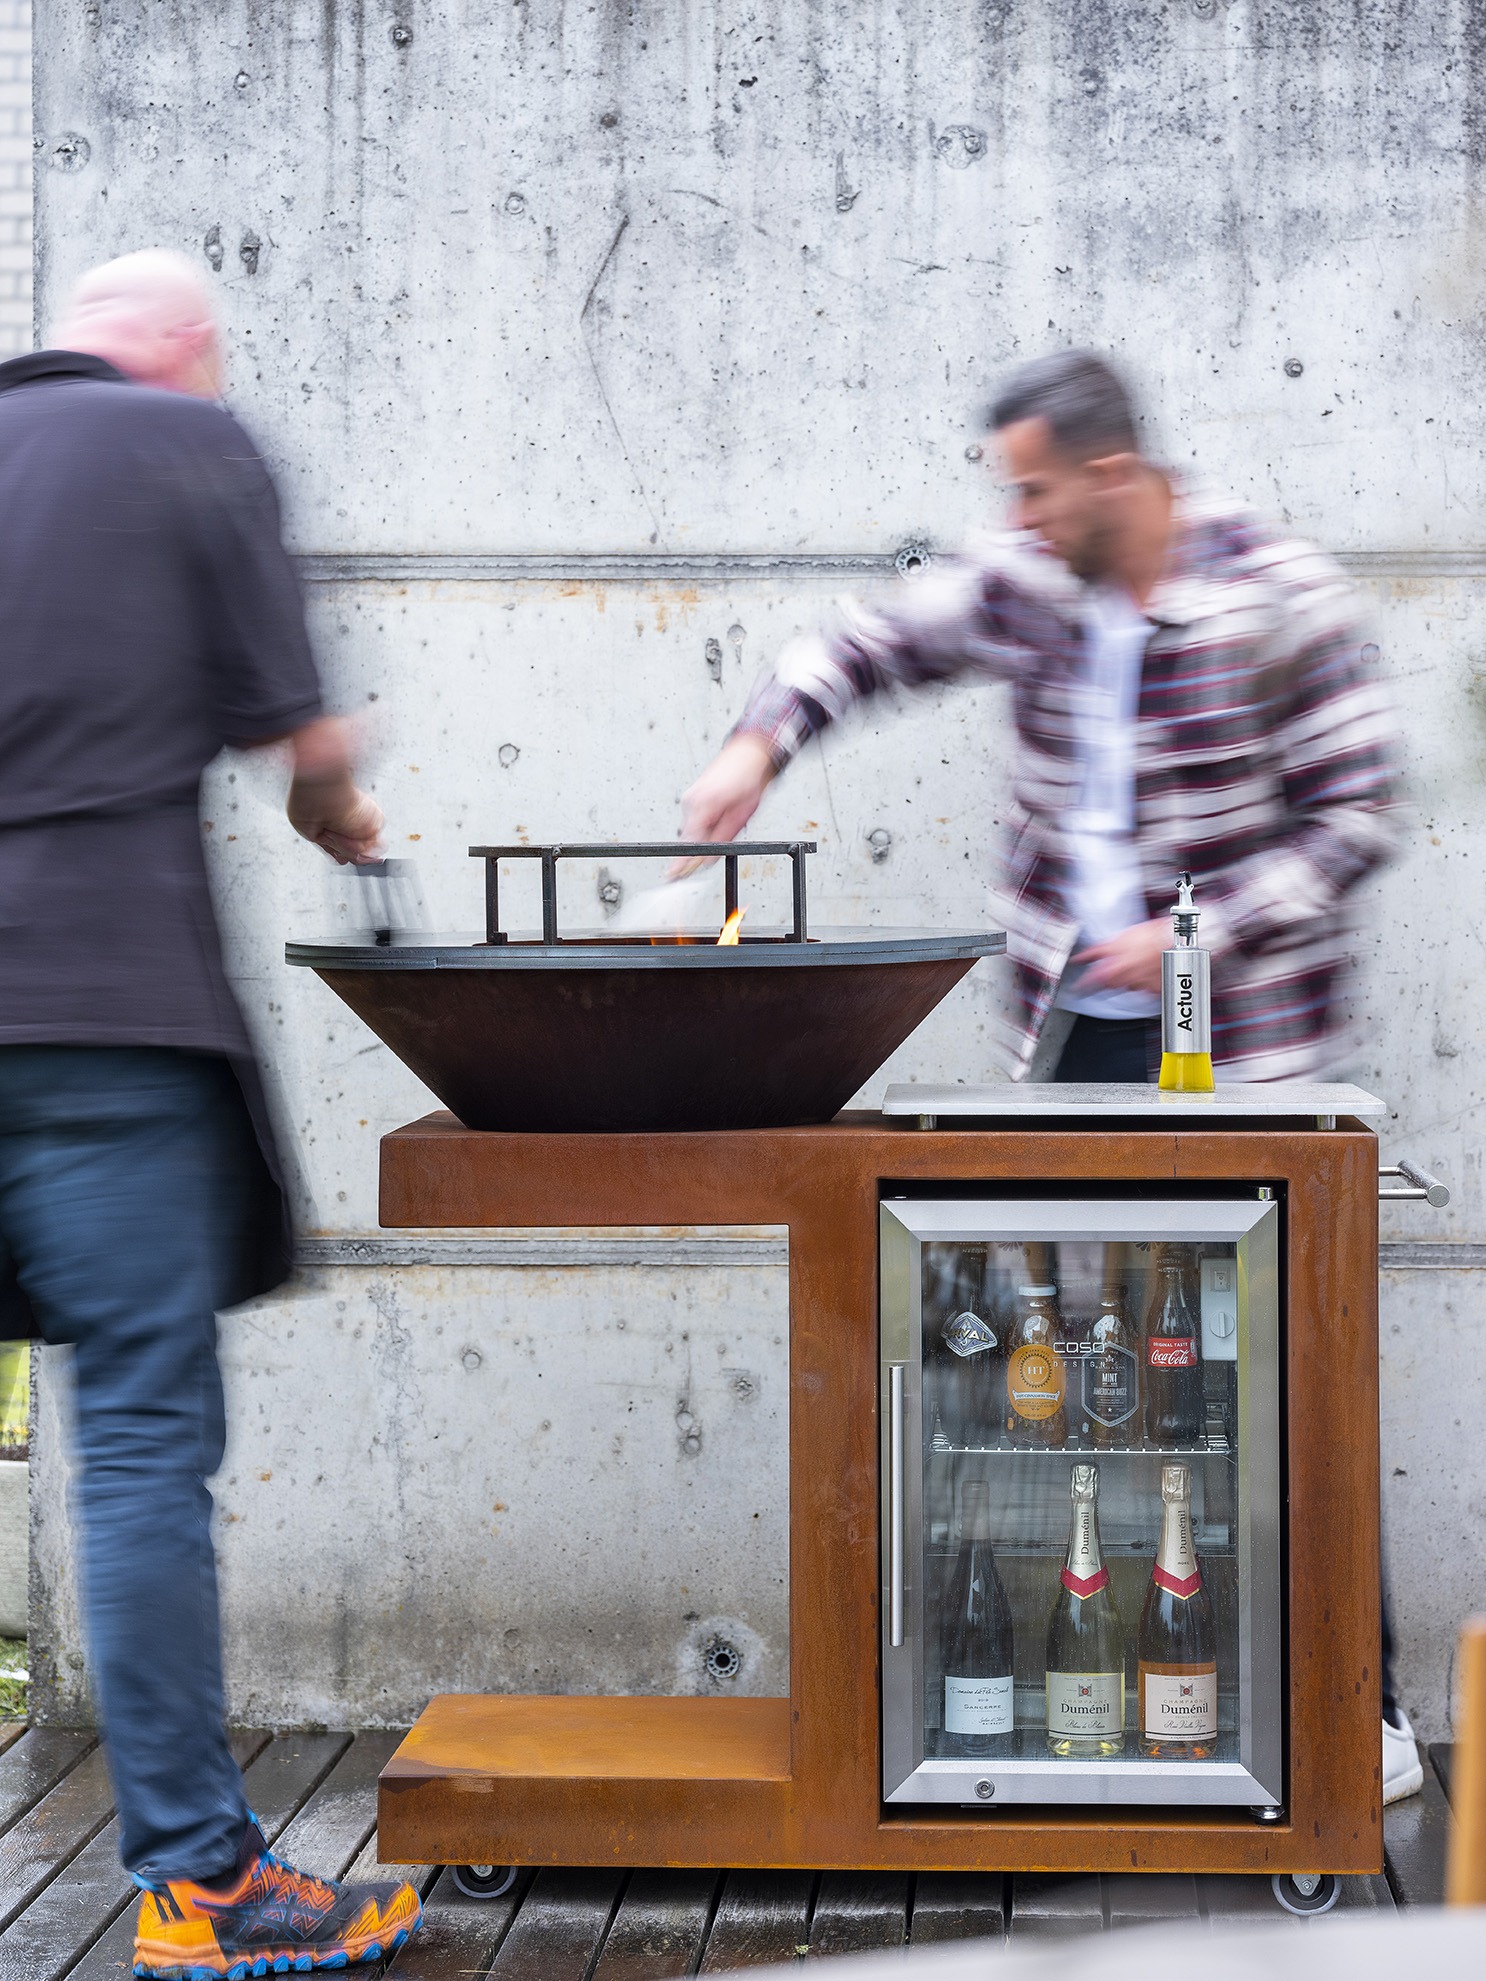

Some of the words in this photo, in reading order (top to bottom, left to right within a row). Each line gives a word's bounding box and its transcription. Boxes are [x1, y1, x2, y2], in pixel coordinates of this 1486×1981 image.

[1177, 973, 1192, 1032] Actuel
[1151, 1349, 1190, 1364] Coca-Cola
[1102, 1373, 1118, 1382] MINT
[1081, 1511, 1089, 1555] Duménil
[1178, 1510, 1187, 1554] Duménil
[1061, 1703, 1109, 1714] Duménil
[1161, 1703, 1208, 1714] Duménil
